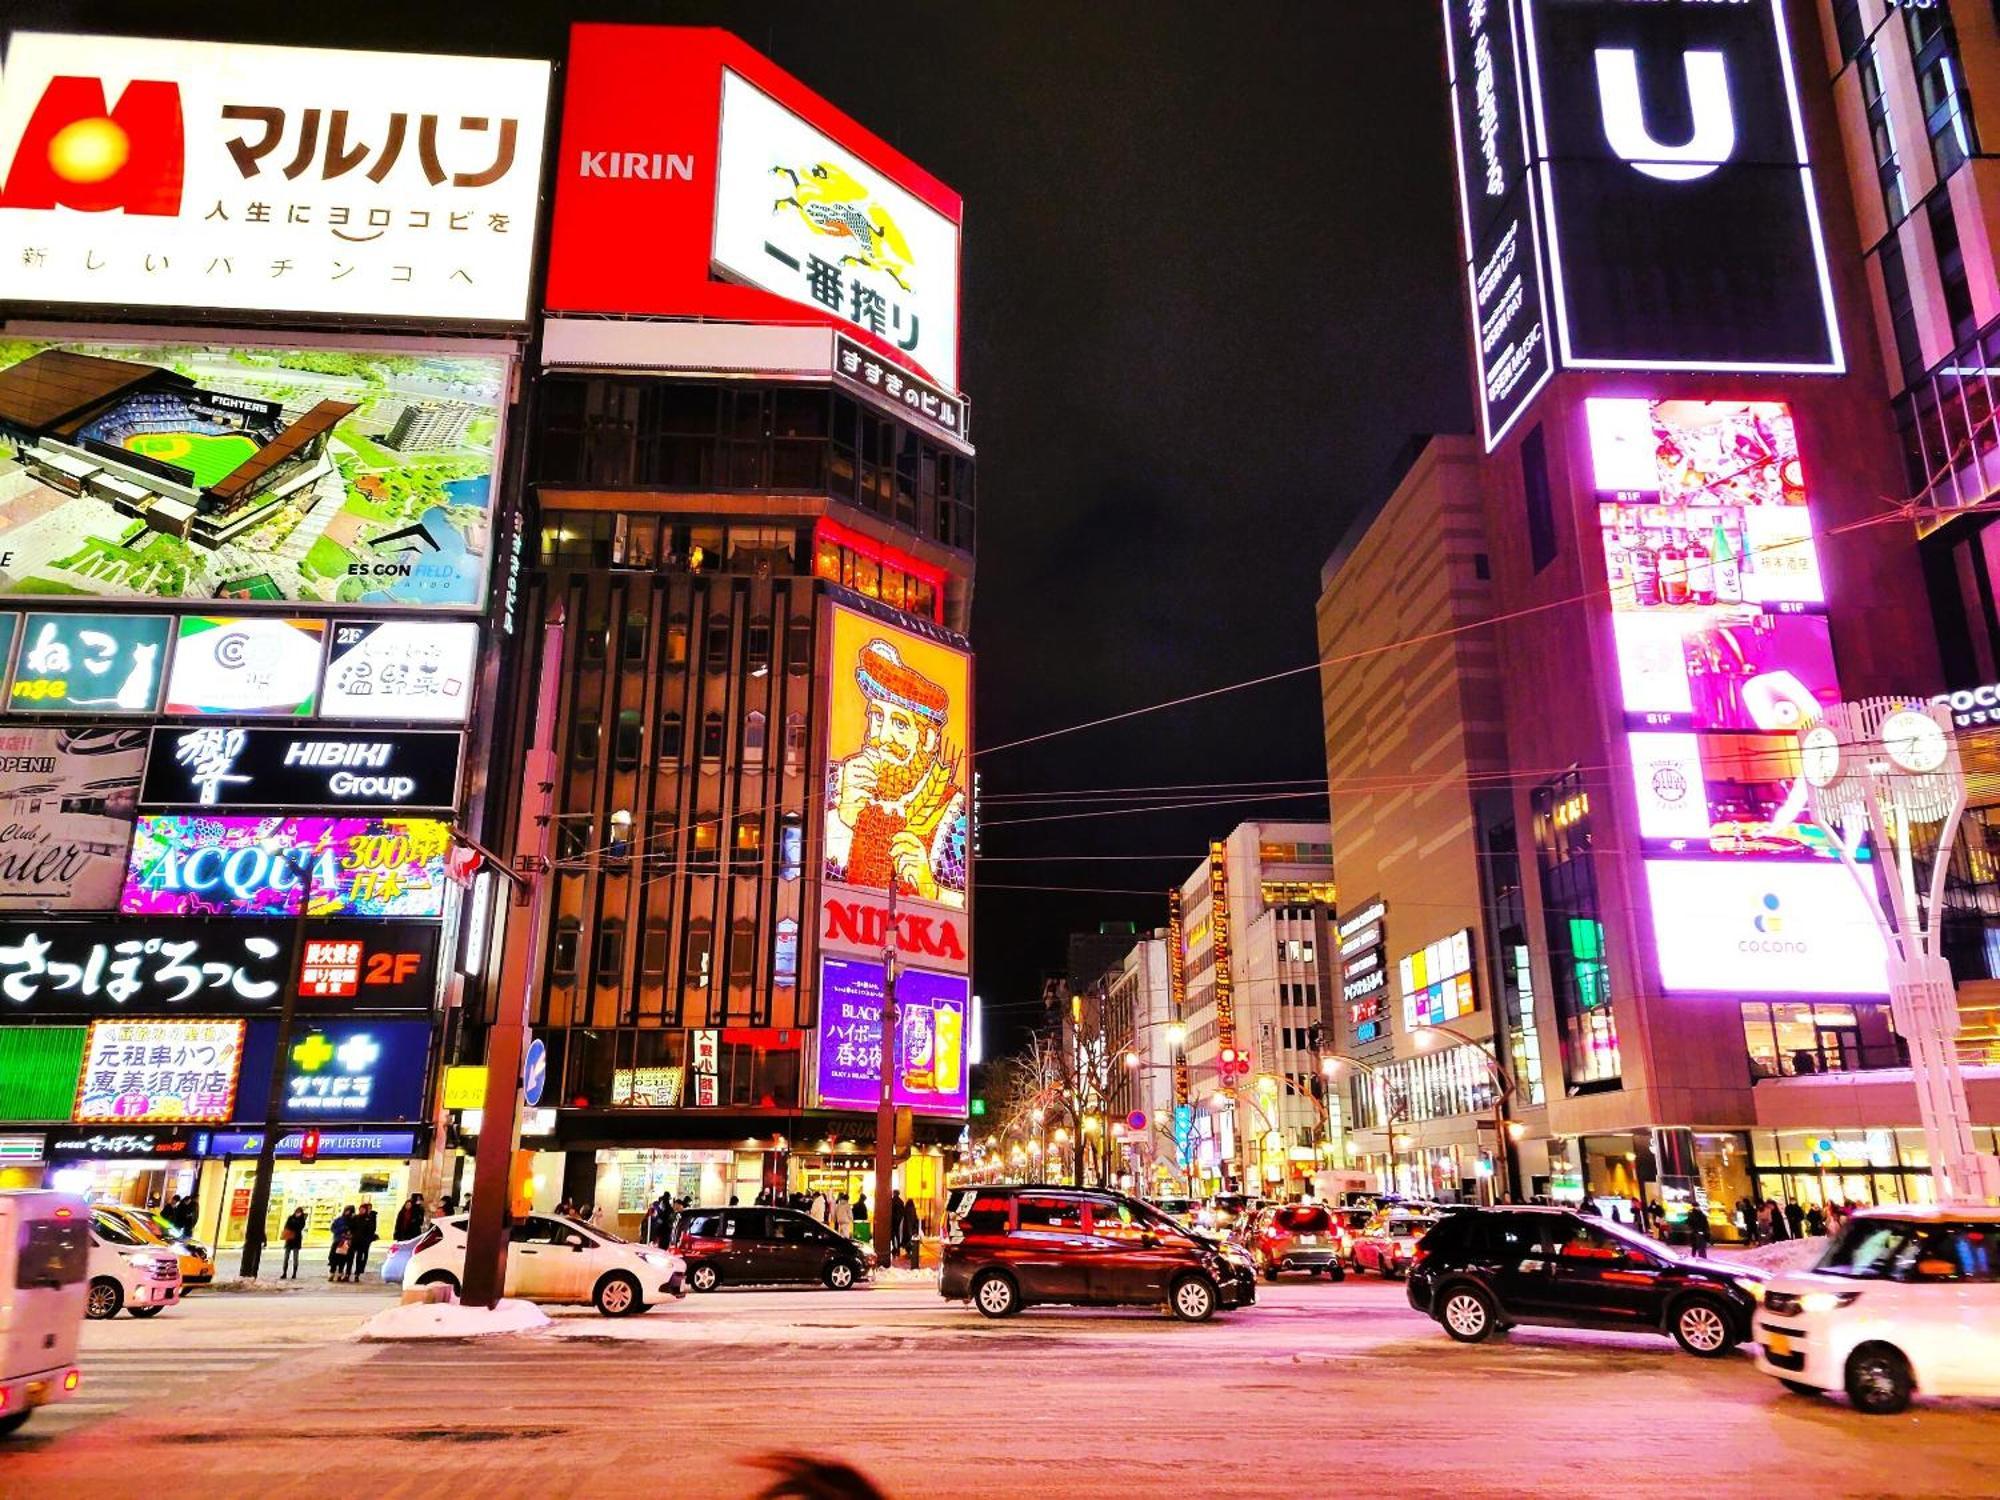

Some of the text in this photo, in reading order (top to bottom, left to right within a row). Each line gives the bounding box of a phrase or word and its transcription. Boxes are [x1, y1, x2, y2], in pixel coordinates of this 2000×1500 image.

[221, 104, 518, 188] マルハン
[580, 150, 694, 181] KIRIN
[204, 200, 512, 235] 人生にヨロコビを
[764, 240, 920, 352] 一番搾り
[842, 349, 956, 427] すすきのビル
[211, 395, 269, 414] FIGHTERS
[347, 563, 369, 576] ES
[27, 622, 118, 675] ねこ
[336, 627, 363, 643] 2F
[174, 729, 255, 805] 響
[284, 742, 393, 767] HIBIKI
[328, 772, 415, 798] Group
[139, 846, 339, 900] ACQUA
[348, 872, 432, 903] 日本一
[823, 898, 965, 961] NIKKA
[1738, 940, 1808, 954] cocono
[0, 932, 280, 1003] さっぽろっこ
[365, 952, 421, 984] 2F
[842, 1003, 881, 1022] BLACK
[826, 1022, 882, 1044] ハイボー
[95, 1044, 216, 1069] 元祖串かつ
[88, 1069, 227, 1094] 恵美須商店
[338, 1136, 383, 1149] LIFESTYLE
